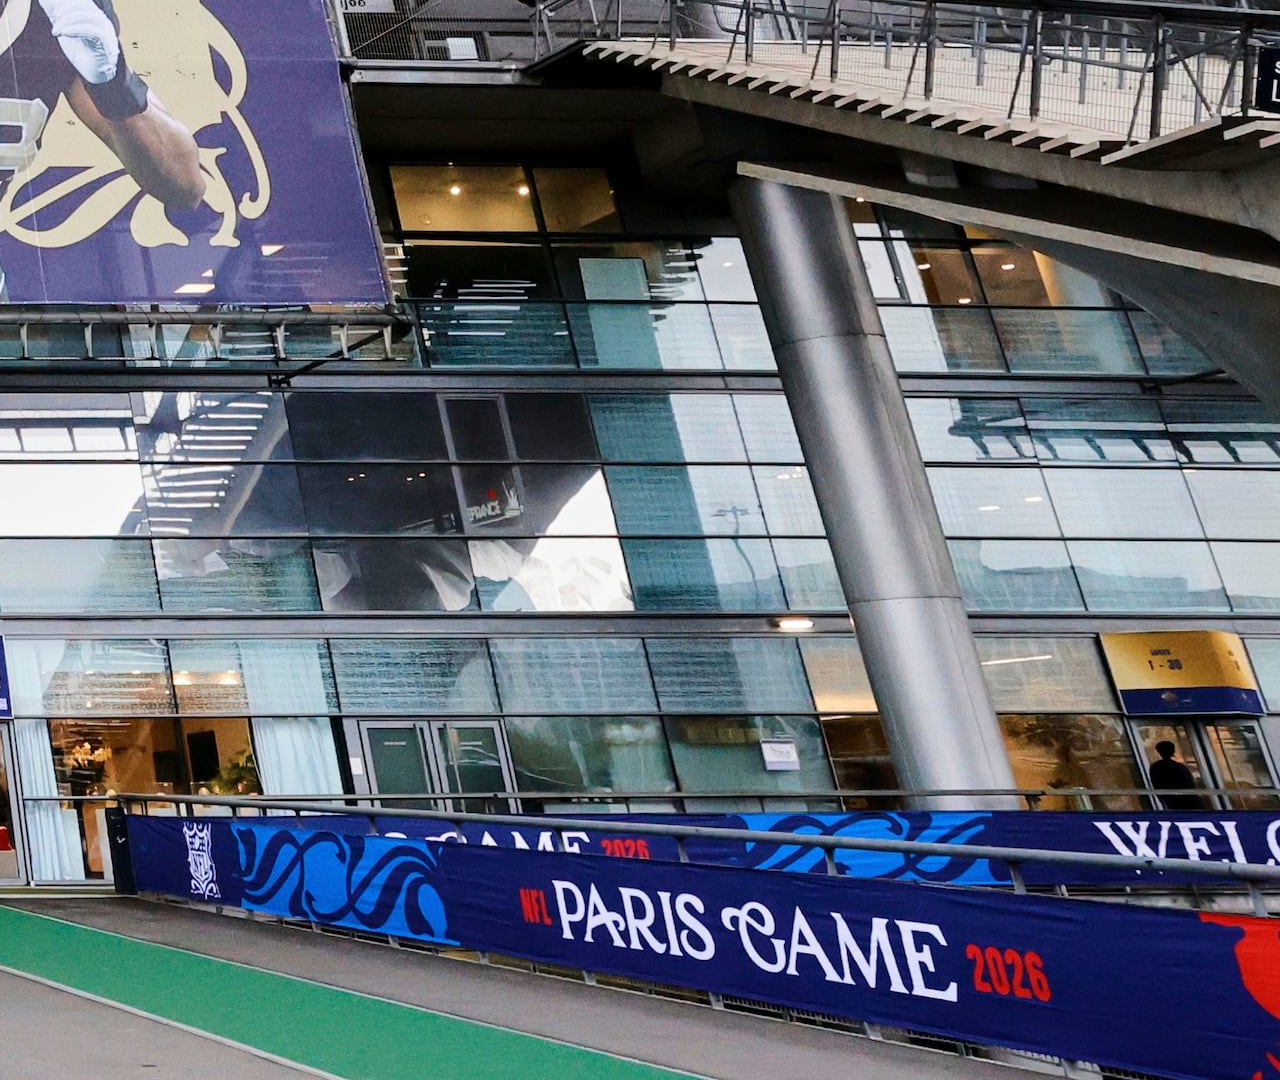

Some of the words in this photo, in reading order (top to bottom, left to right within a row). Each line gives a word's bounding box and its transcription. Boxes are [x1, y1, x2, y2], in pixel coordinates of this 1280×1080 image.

[519, 888, 552, 926] NFL
[551, 879, 715, 961] PARIS
[721, 901, 958, 1003] GAME
[966, 943, 1052, 1002] 2026
